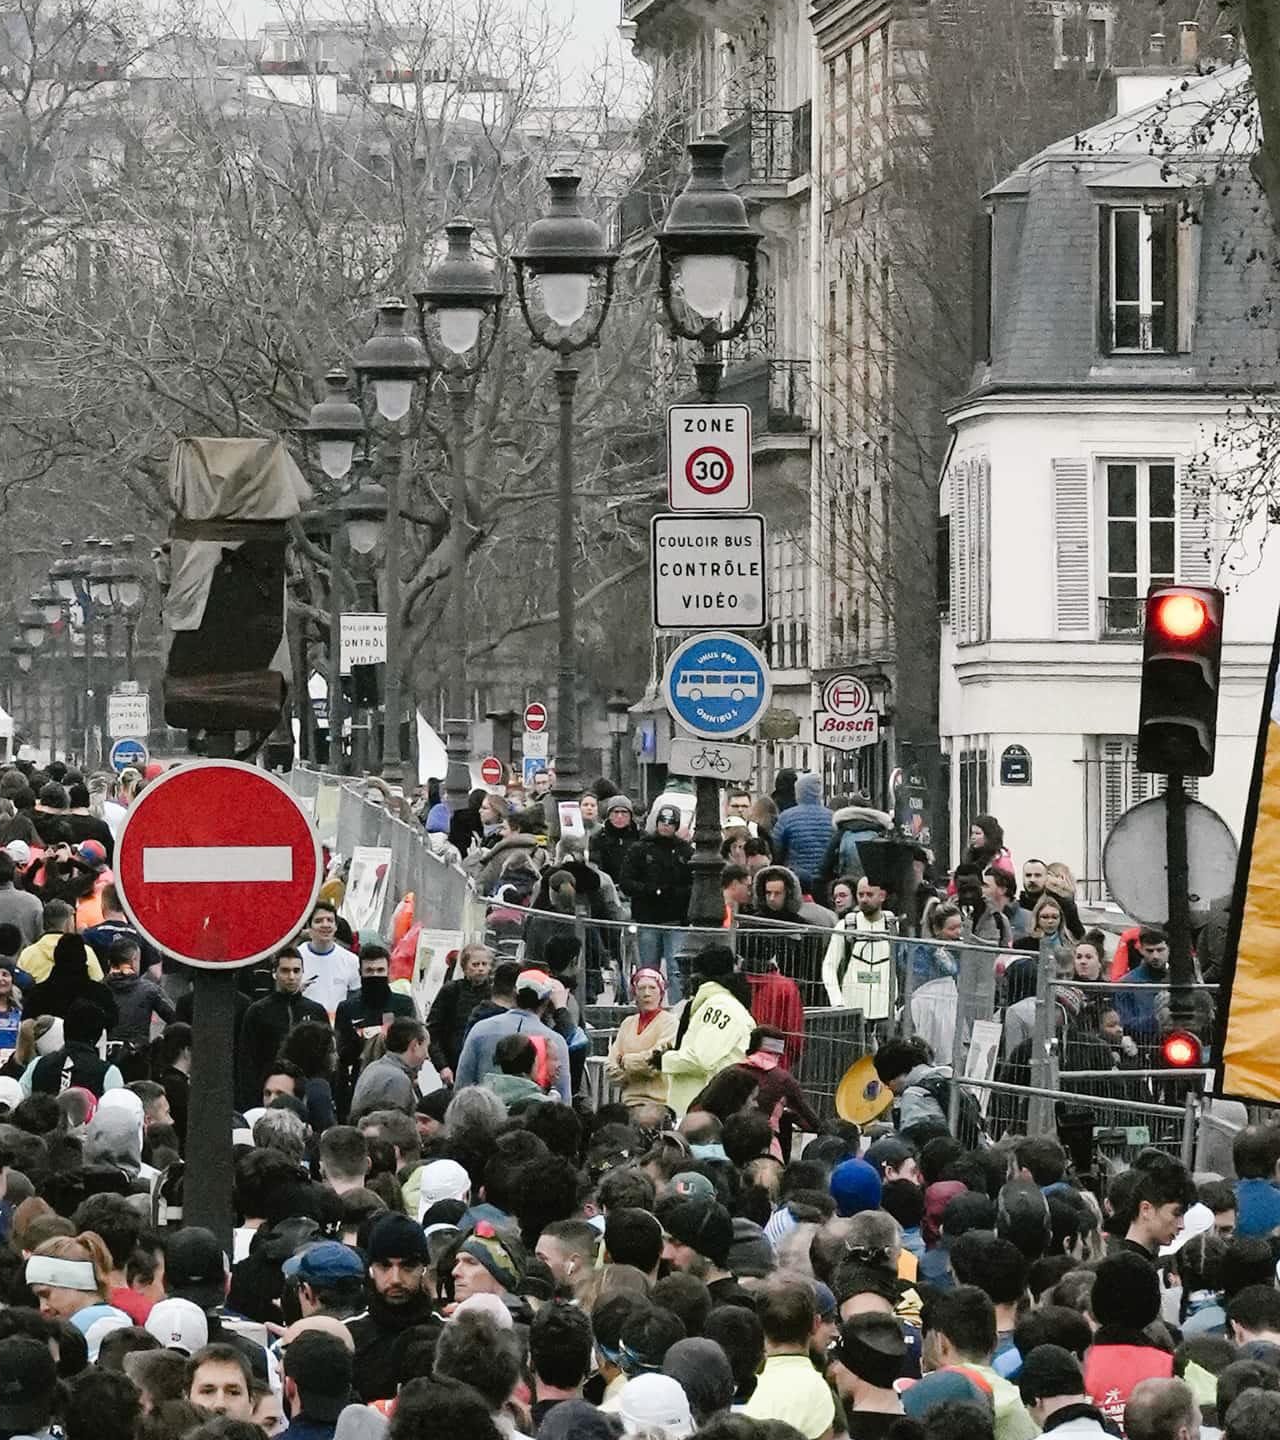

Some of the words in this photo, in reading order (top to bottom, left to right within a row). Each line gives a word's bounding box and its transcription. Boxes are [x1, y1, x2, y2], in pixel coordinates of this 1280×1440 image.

[684, 419, 735, 433] ZONE
[695, 461, 724, 481] 30
[658, 536, 720, 547] COULOIR
[725, 536, 752, 547] BUS
[660, 559, 760, 577] CONTRÔLE
[682, 592, 738, 609] VIDÉO
[696, 707, 739, 723] OMNIBUS
[819, 717, 874, 734] Bosch
[829, 734, 867, 744] DIENST
[703, 1006, 730, 1030] 683
